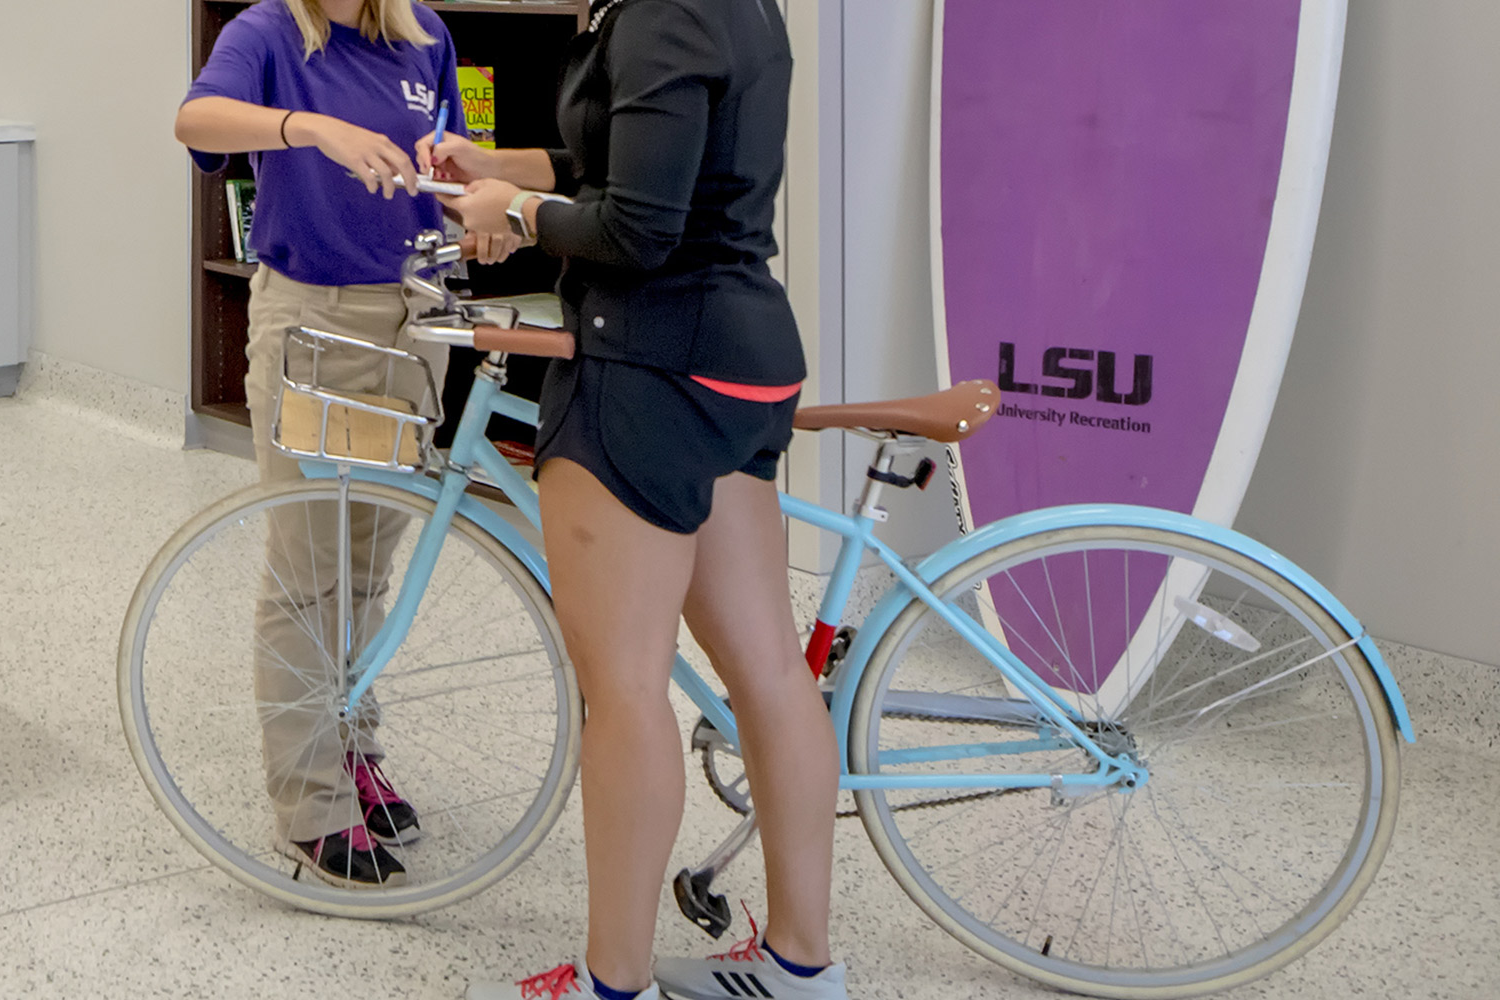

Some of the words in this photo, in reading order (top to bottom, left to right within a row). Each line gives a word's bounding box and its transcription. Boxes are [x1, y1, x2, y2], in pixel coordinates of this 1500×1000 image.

[401, 80, 435, 112] LSU
[998, 342, 1153, 406] LSU
[996, 403, 1066, 427] University
[1069, 411, 1151, 433] Recreation
